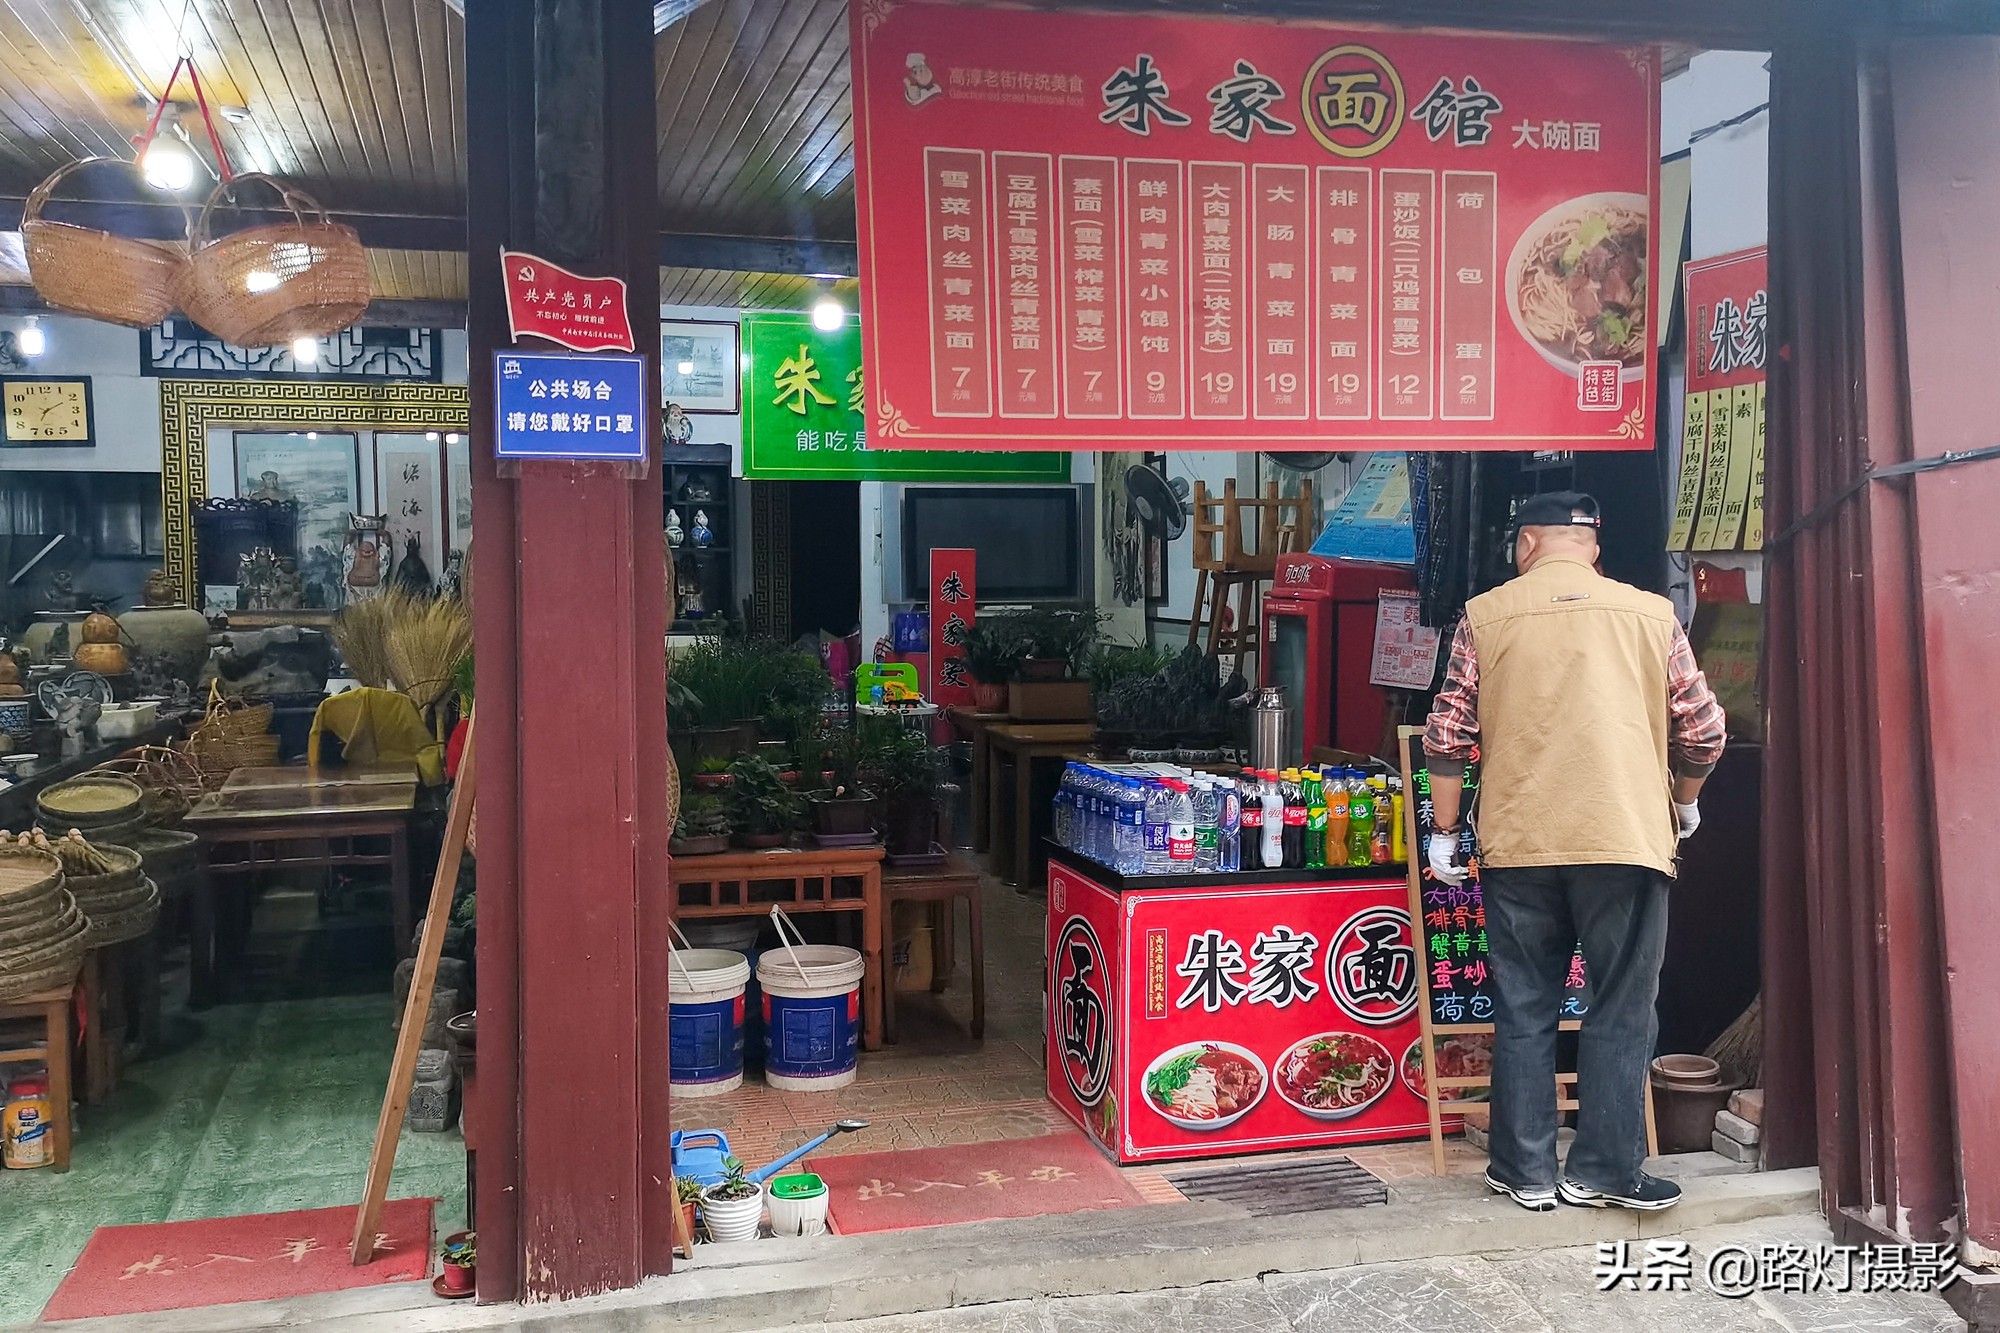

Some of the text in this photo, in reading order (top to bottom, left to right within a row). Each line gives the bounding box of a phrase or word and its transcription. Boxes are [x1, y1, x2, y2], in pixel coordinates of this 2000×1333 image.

[948, 67, 1084, 93] 高淳老街传统美食
[1099, 53, 1503, 148] 朱家面馆
[1511, 119, 1601, 152] 大碗面
[940, 170, 974, 350] 雪菜肉丝青菜面
[1007, 174, 1041, 351] 豆腐干雪菜肉丝青菜面
[1138, 179, 1170, 353] 鲜肉青菜小馄饨
[1266, 186, 1295, 355] 大肠青菜面
[1330, 189, 1358, 358] 排骨青菜面
[1456, 192, 1485, 359] 荷包蛋
[523, 287, 612, 310] 共产党员户
[536, 310, 568, 321] 不忘初心
[951, 366, 971, 388] 7
[1017, 368, 1037, 389] 7
[1083, 370, 1102, 391] 7
[1146, 371, 1166, 391] 9
[1200, 372, 1234, 393] 19
[1264, 372, 1297, 393] 19
[1327, 373, 1360, 394] 19
[1388, 374, 1420, 394] 12
[1459, 374, 1477, 395] 2
[1584, 369, 1600, 402] 特色
[1601, 368, 1615, 402] 老街
[13, 394, 25, 402] 10
[26, 386, 34, 395] 11
[39, 386, 51, 394] 12
[58, 386, 62, 395] 1
[68, 393, 78, 401] 2
[529, 379, 613, 401] 公共场合
[12, 407, 22, 416] 9
[72, 406, 80, 414] 3
[16, 420, 25, 430] 8
[30, 427, 39, 436] 7
[44, 427, 54, 436] 6
[58, 426, 68, 435] 5
[70, 419, 79, 427] 4
[507, 411, 634, 433] 请您戴好口罩
[1677, 410, 1704, 519] 豆腐干肉丝青菜面
[1702, 406, 1729, 517] 雪菜肉丝青菜面
[1674, 532, 1685, 544] 7
[1700, 531, 1711, 543] 7
[1722, 530, 1734, 542] 7
[1753, 529, 1762, 542] 9
[1061, 938, 1106, 1085] 面
[1435, 990, 1495, 1022] 荷包
[856, 1164, 1082, 1201] 出入平安
